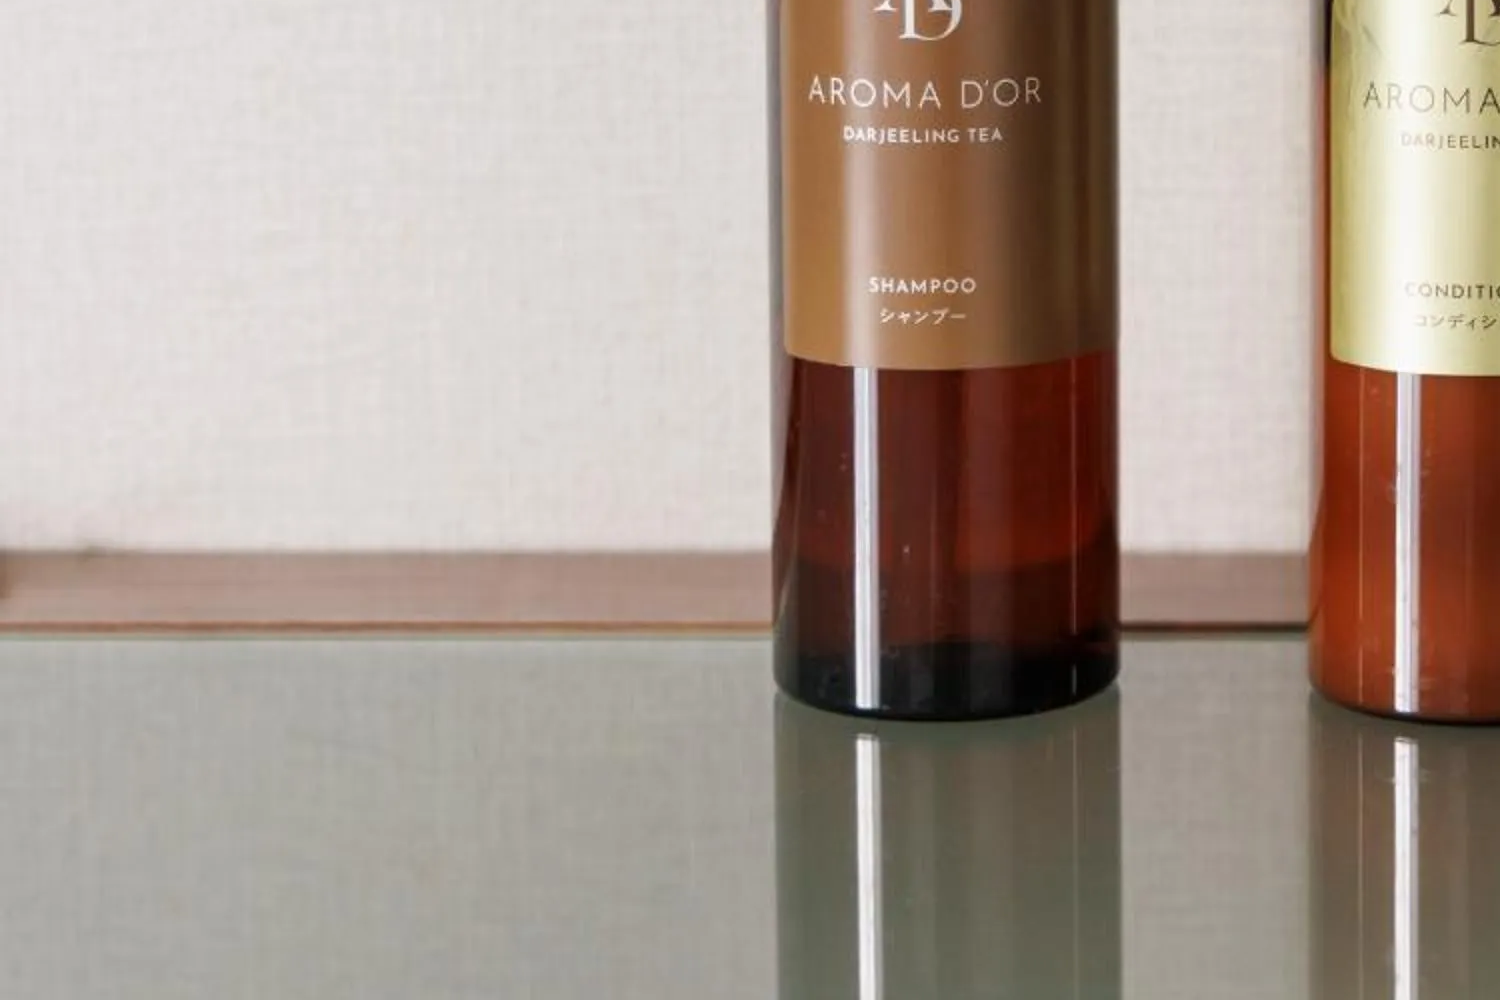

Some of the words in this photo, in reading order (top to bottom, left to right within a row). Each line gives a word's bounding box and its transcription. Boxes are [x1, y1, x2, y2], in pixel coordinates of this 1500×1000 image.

[808, 75, 941, 110] AROMA
[960, 77, 1042, 109] D'OR
[1363, 81, 1500, 115] AROMA
[843, 125, 960, 144] DARJEELING
[968, 127, 1003, 143] TEA
[868, 276, 977, 294] SHAMPOO
[879, 307, 967, 326] シャンプー
